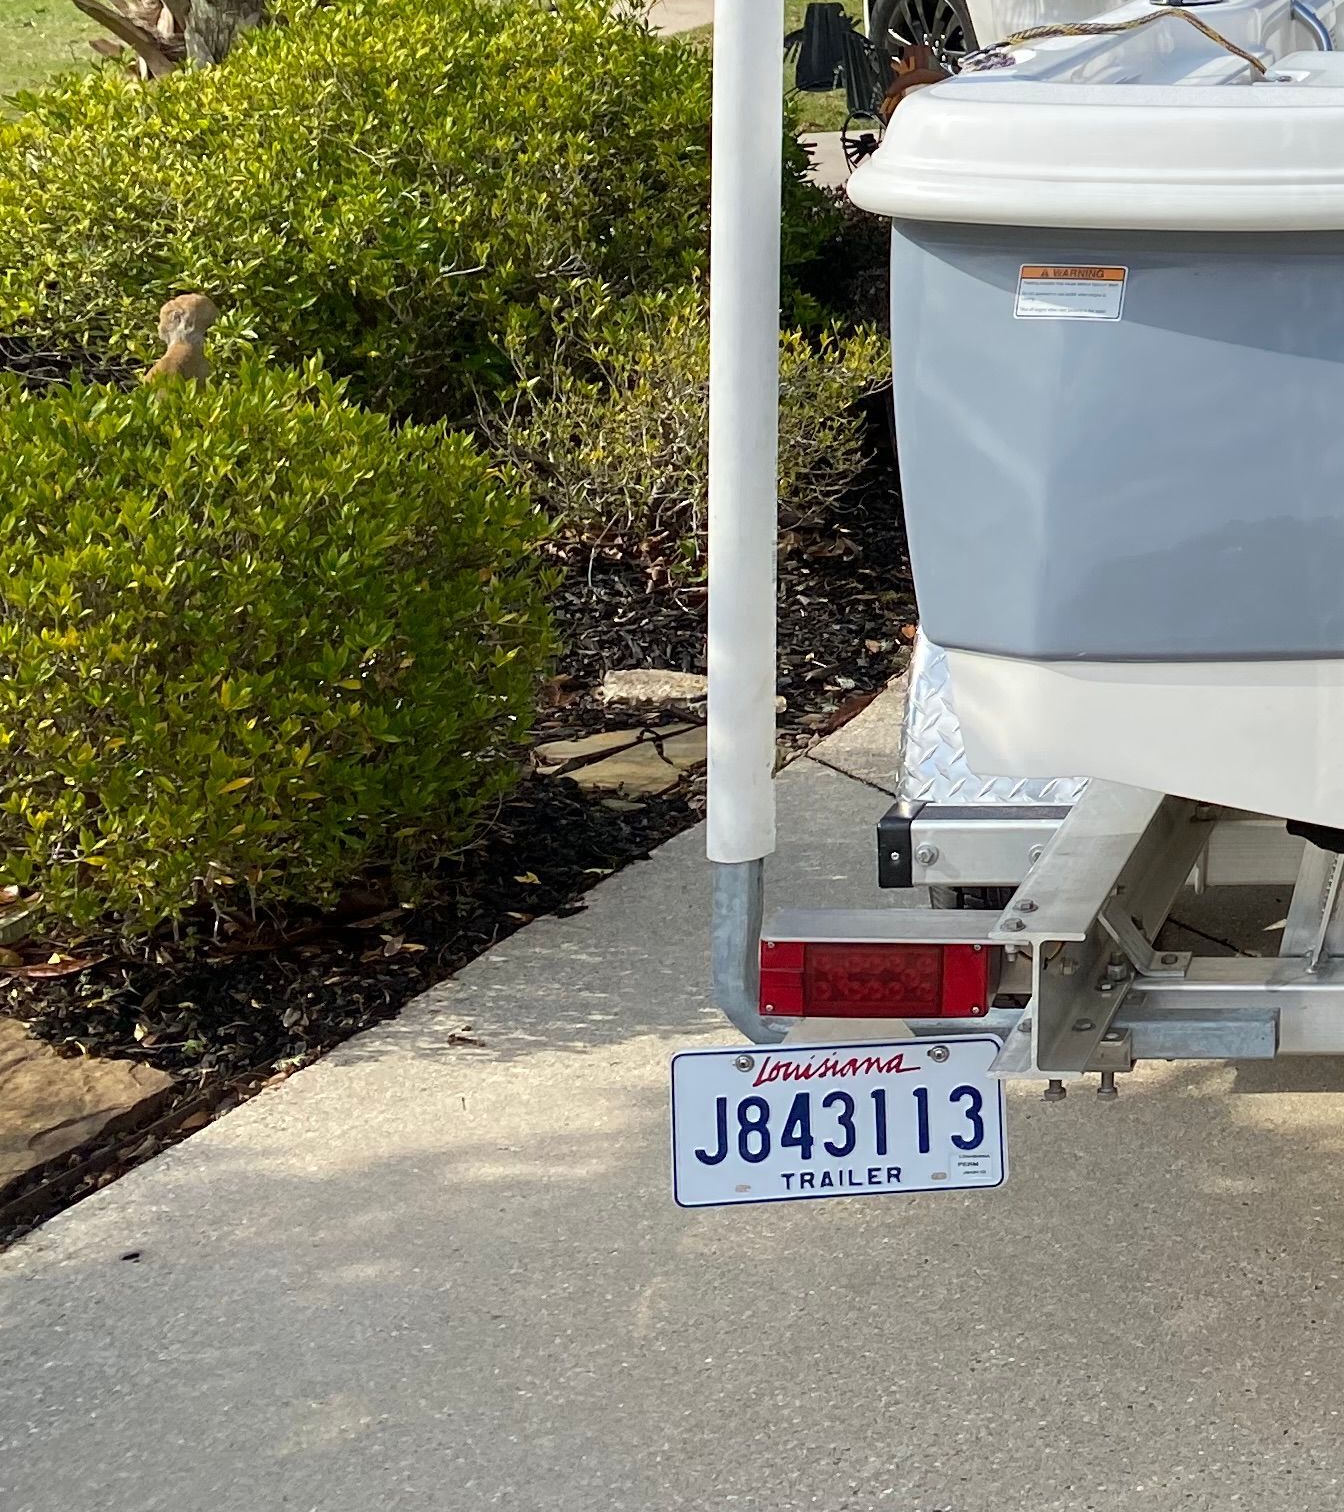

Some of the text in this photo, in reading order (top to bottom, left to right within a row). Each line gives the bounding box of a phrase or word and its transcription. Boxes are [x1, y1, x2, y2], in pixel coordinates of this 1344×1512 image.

[1053, 269, 1105, 278] WARNING
[751, 1051, 921, 1087] Louisiana
[694, 1084, 986, 1166] J843113
[781, 1166, 903, 1190] TRAILER
